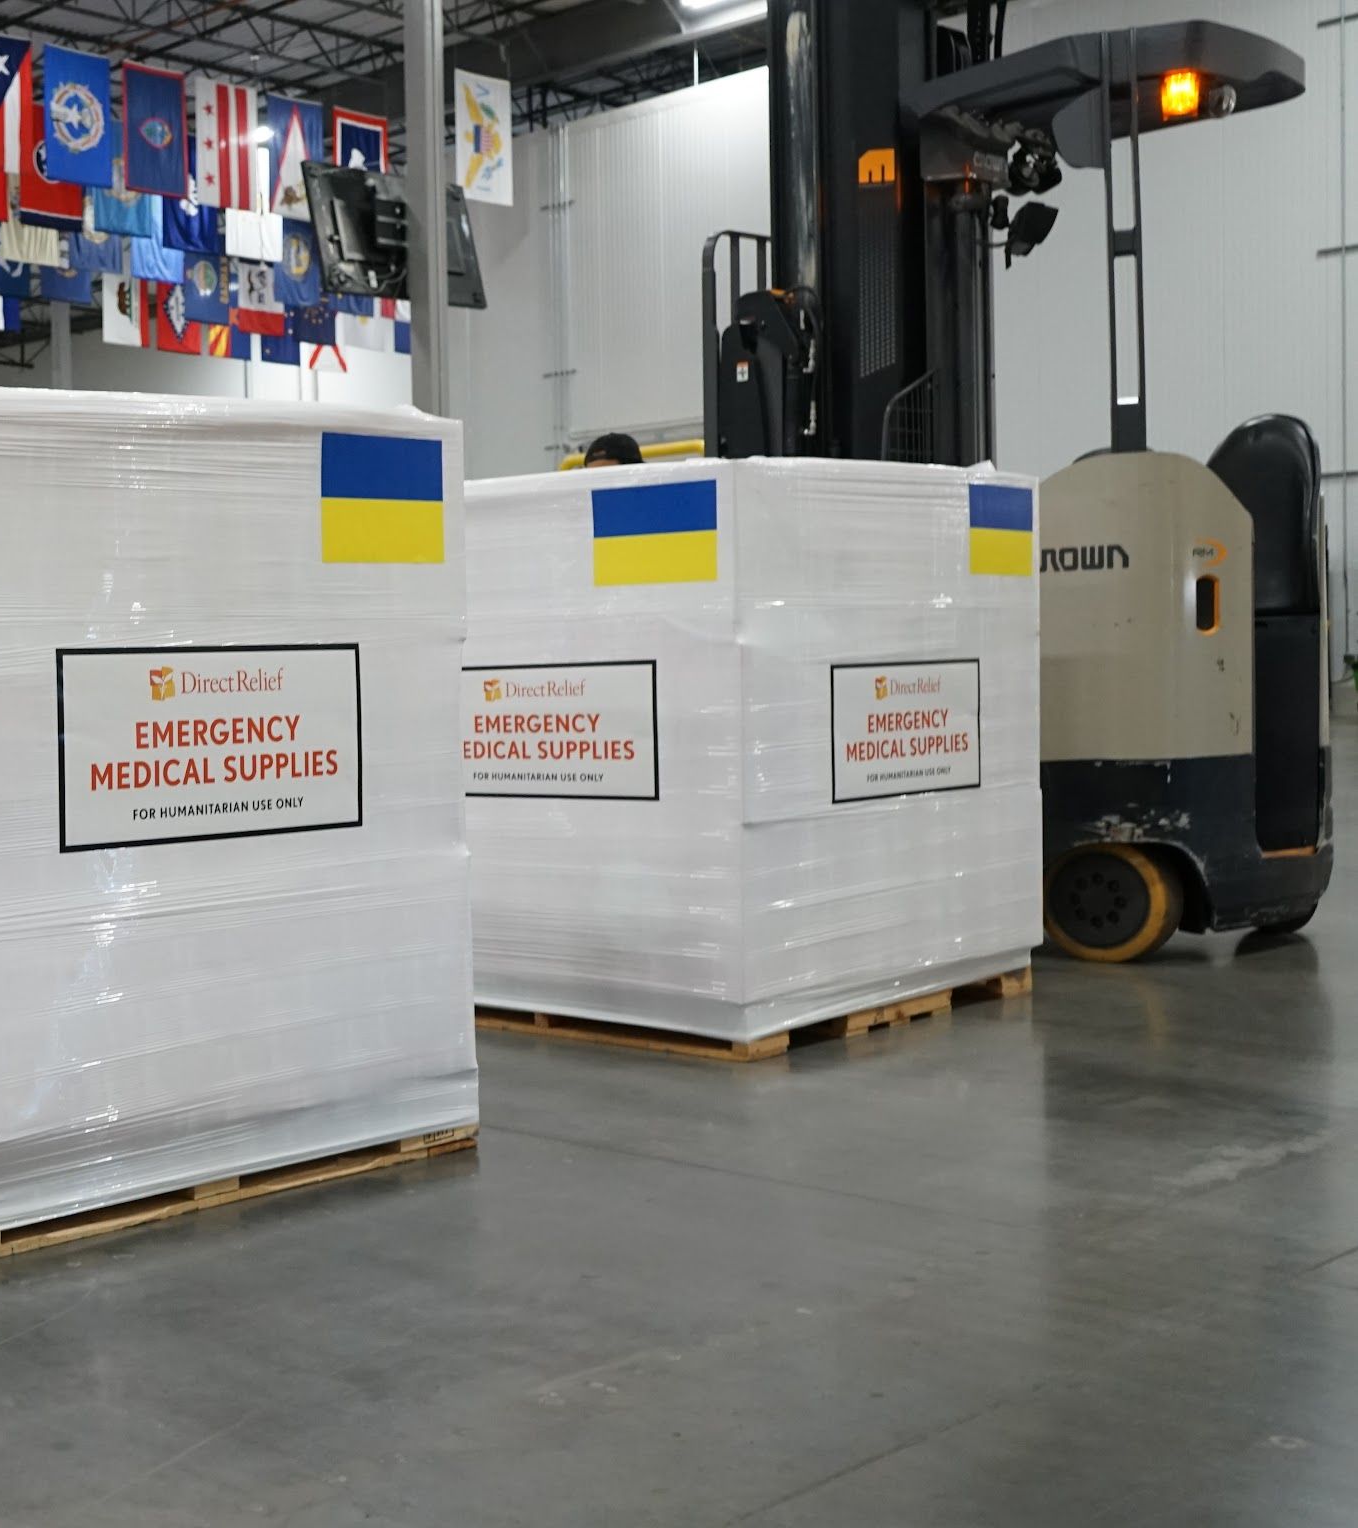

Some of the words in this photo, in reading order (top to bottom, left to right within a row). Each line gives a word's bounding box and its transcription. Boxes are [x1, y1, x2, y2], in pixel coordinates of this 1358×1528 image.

[181, 671, 234, 695] Direct
[236, 667, 284, 692] Relief
[506, 680, 545, 698] Direct
[547, 677, 586, 697] Relief
[890, 678, 916, 696] Direct
[917, 674, 942, 694] Relief
[136, 714, 301, 750] EMERGENCY
[474, 713, 600, 734] EMERGENCY
[868, 709, 949, 733] EMERGENCY
[538, 740, 635, 760] SUPPLIES
[846, 738, 906, 763] MEDICAL
[910, 733, 969, 757] SUPPLIES
[91, 757, 215, 792] MEDICAL
[224, 749, 338, 783] SUPPLIES
[473, 771, 489, 780] FOR
[491, 771, 558, 781] HUMANITARIAN
[560, 772, 577, 782] USE
[579, 772, 604, 782] ONLY
[866, 773, 878, 783] FOR
[880, 770, 923, 782] HUMANITARIAN
[925, 768, 935, 777] USE
[936, 766, 951, 776] ONLY
[133, 807, 156, 821] FOR
[160, 801, 249, 819] HUMANITARIAN
[252, 799, 272, 811] USE
[276, 796, 304, 809] ONLY
